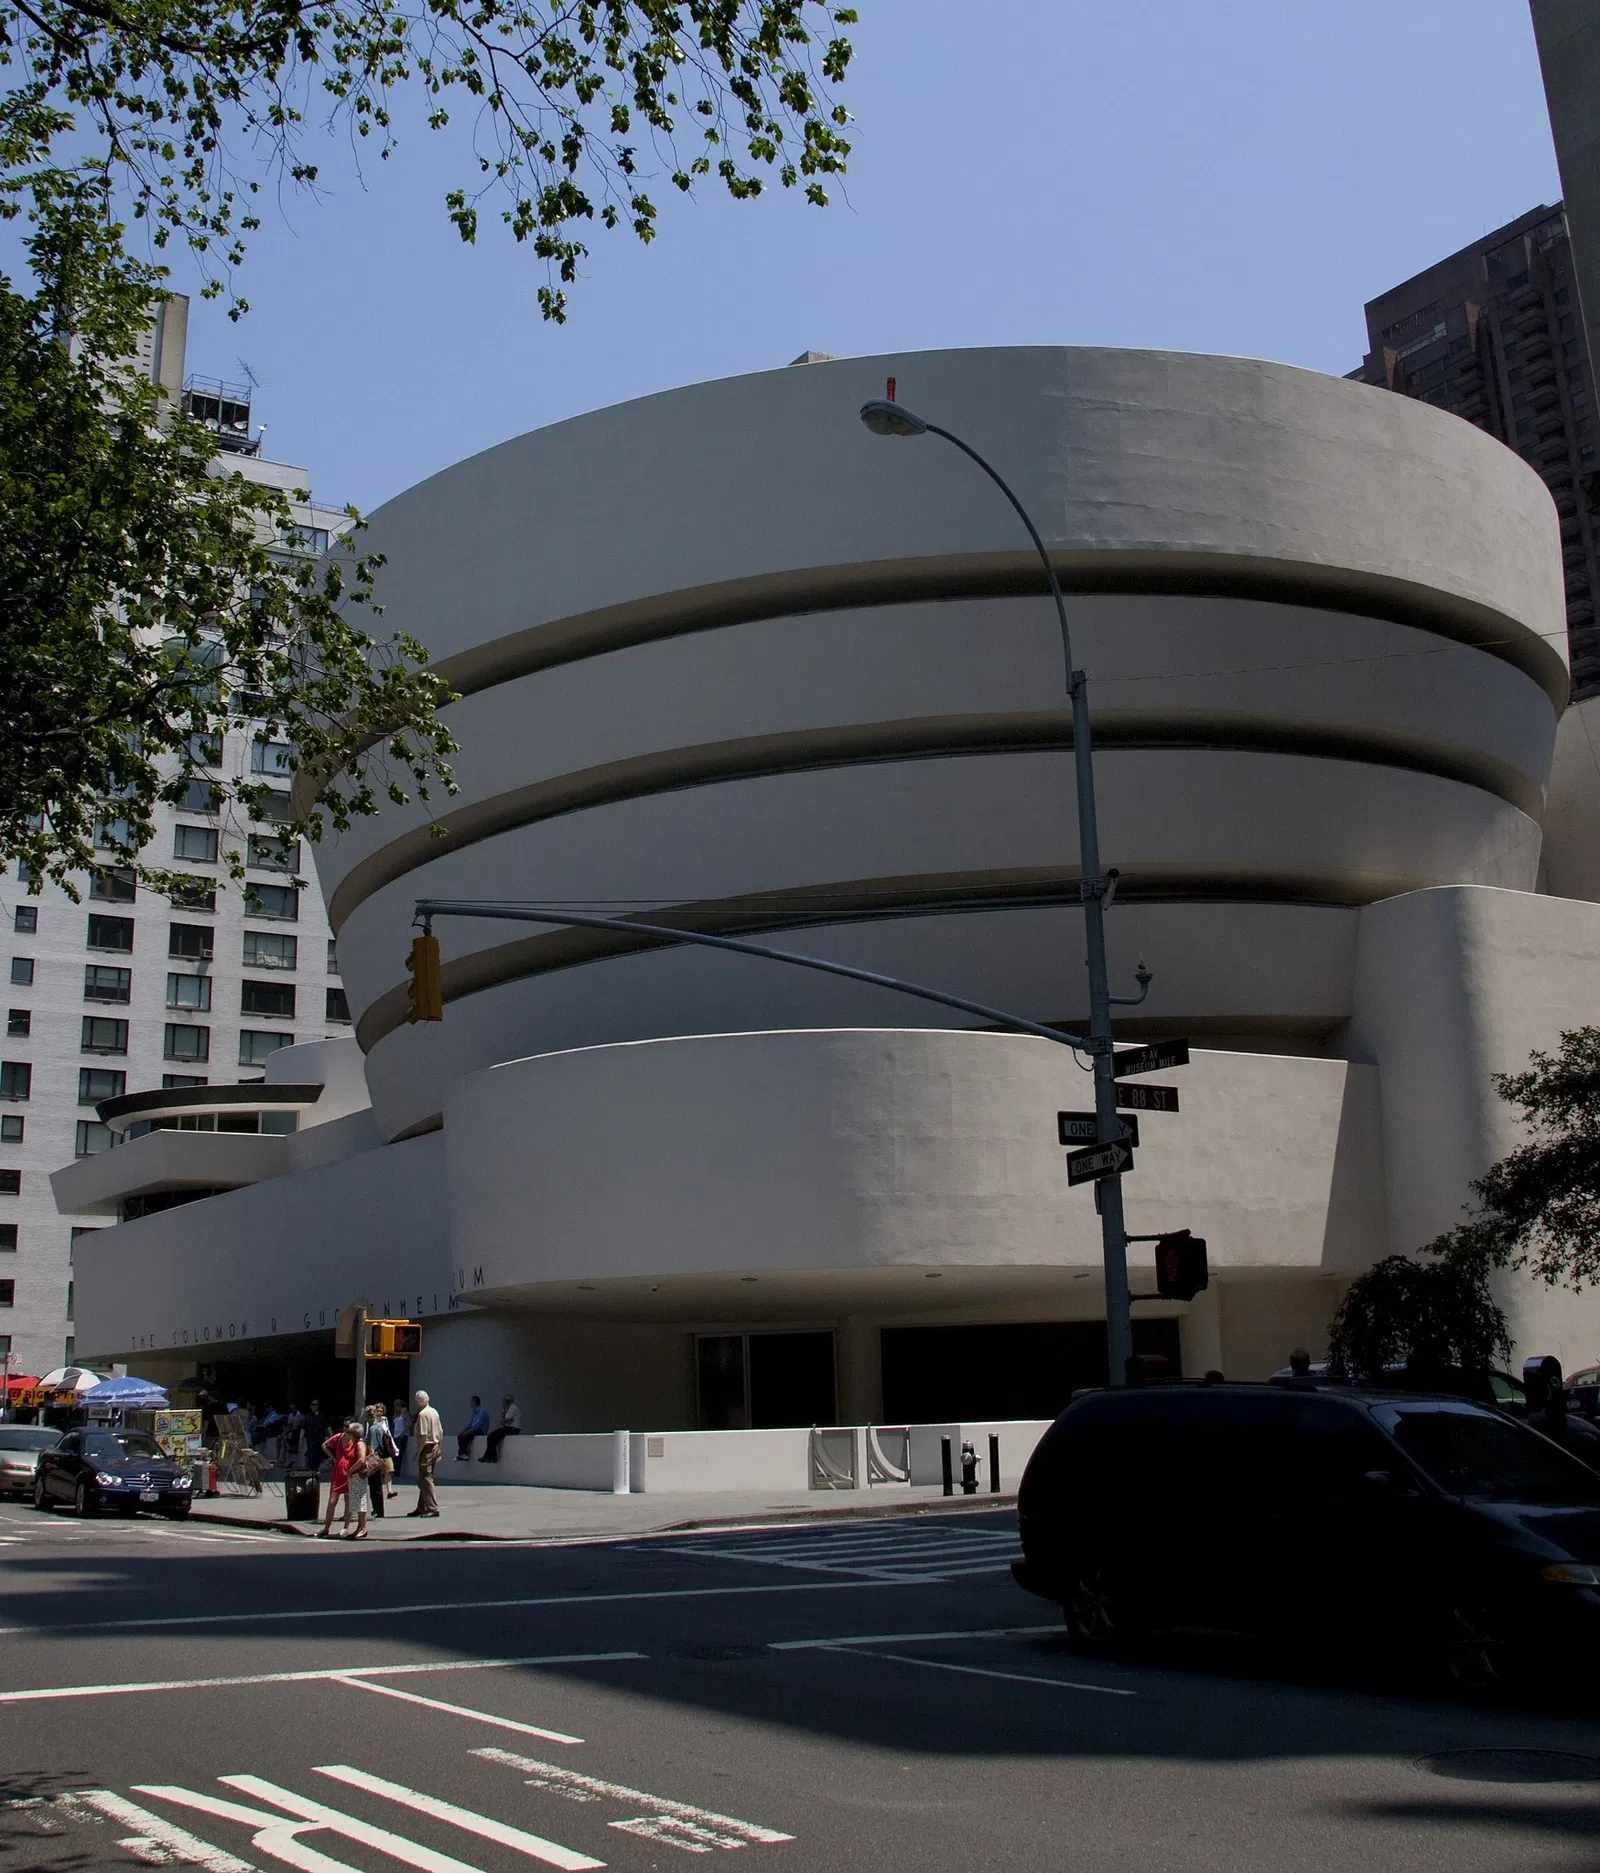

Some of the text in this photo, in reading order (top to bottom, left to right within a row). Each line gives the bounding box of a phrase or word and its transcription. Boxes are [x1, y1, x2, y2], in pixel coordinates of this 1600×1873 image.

[1125, 1055, 1177, 1075] MUSEUM MILE
[1140, 1048, 1159, 1062] 5 AV
[1117, 1087, 1167, 1109] E 88 ST
[1070, 1123, 1094, 1136] ONE
[1075, 1149, 1121, 1173] ONE WAY
[132, 1334, 154, 1350] THE
[172, 1321, 248, 1345] SOLOMON
[303, 1293, 459, 1329] GUNHEIM
[25, 1390, 43, 1400] BIG
